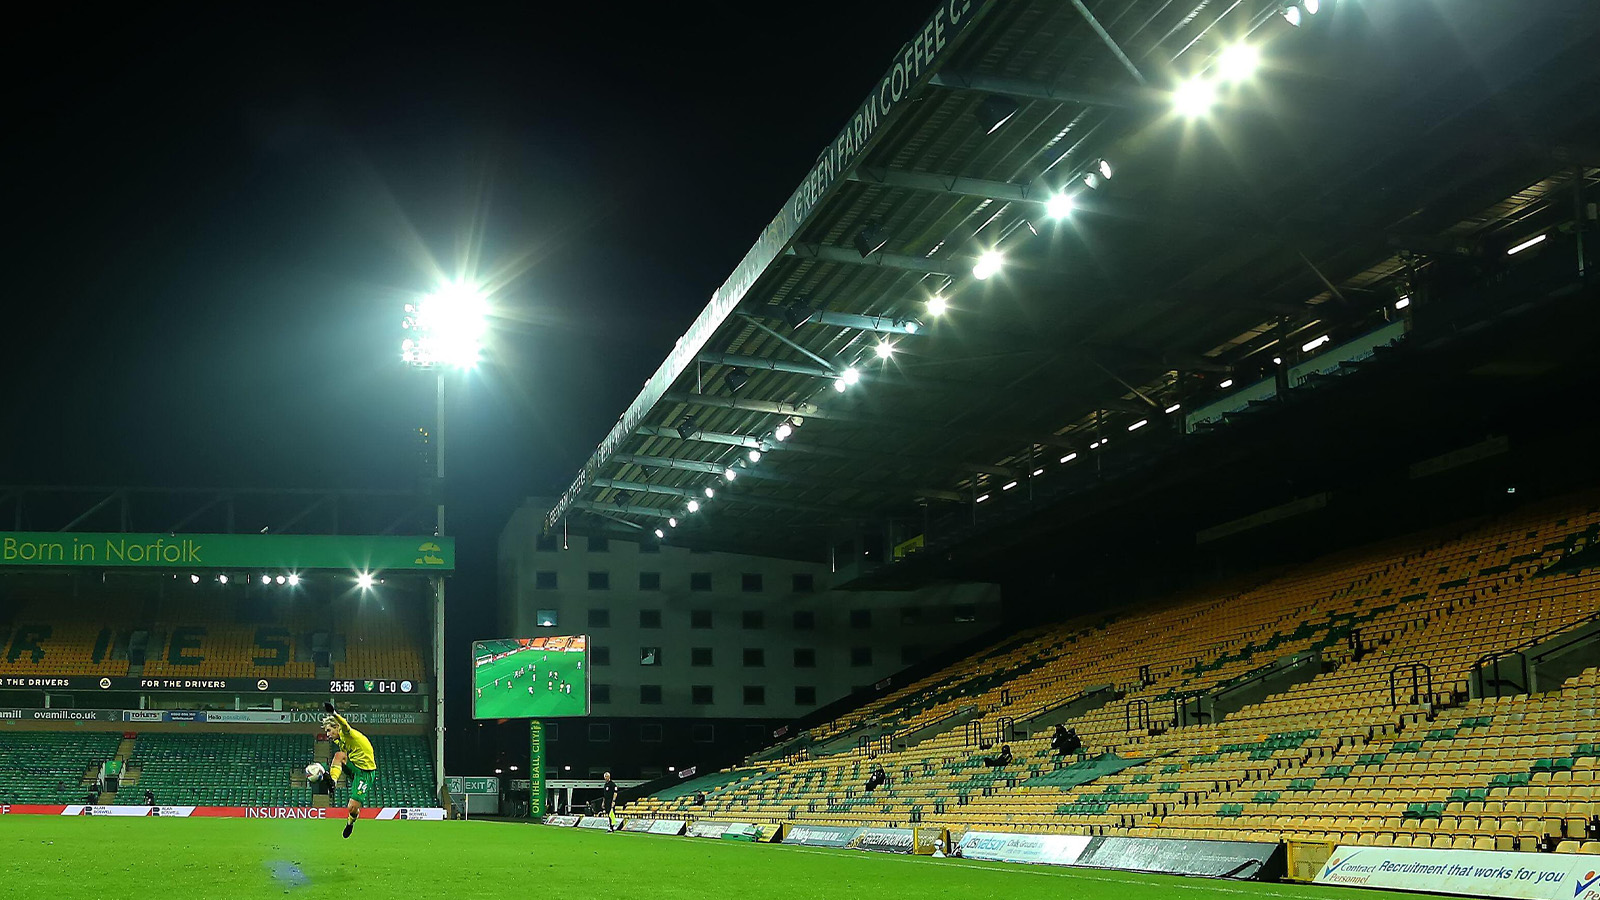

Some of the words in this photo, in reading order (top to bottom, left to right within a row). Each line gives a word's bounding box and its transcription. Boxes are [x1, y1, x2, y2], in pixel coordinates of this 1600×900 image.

[794, 149, 834, 223] GREEN
[837, 94, 878, 172] FARM
[880, 7, 946, 116] COFFEE
[4, 538, 63, 560] Born
[73, 538, 95, 561] in
[106, 539, 202, 562] Norfolk
[7, 678, 25, 686] THE
[28, 679, 70, 687] DRIVERS
[163, 680, 181, 688] THE
[185, 680, 226, 688] DRIVERS
[330, 681, 355, 693] 25:55
[379, 681, 397, 693] 0-0
[34, 711, 96, 719] ovamill.co.uk
[532, 755, 540, 778] BALL,
[357, 780, 367, 793] 14
[465, 782, 485, 790] EXIT
[532, 780, 540, 796] THE
[532, 799, 540, 813] ON
[245, 807, 326, 819] INSURANCE
[1341, 862, 1376, 873] Contract
[1379, 860, 1448, 875] Recruitment
[1447, 864, 1474, 877] that
[1474, 866, 1513, 879] works
[1514, 867, 1536, 880] for
[1534, 872, 1565, 885] you
[1329, 873, 1370, 884] Personnel
